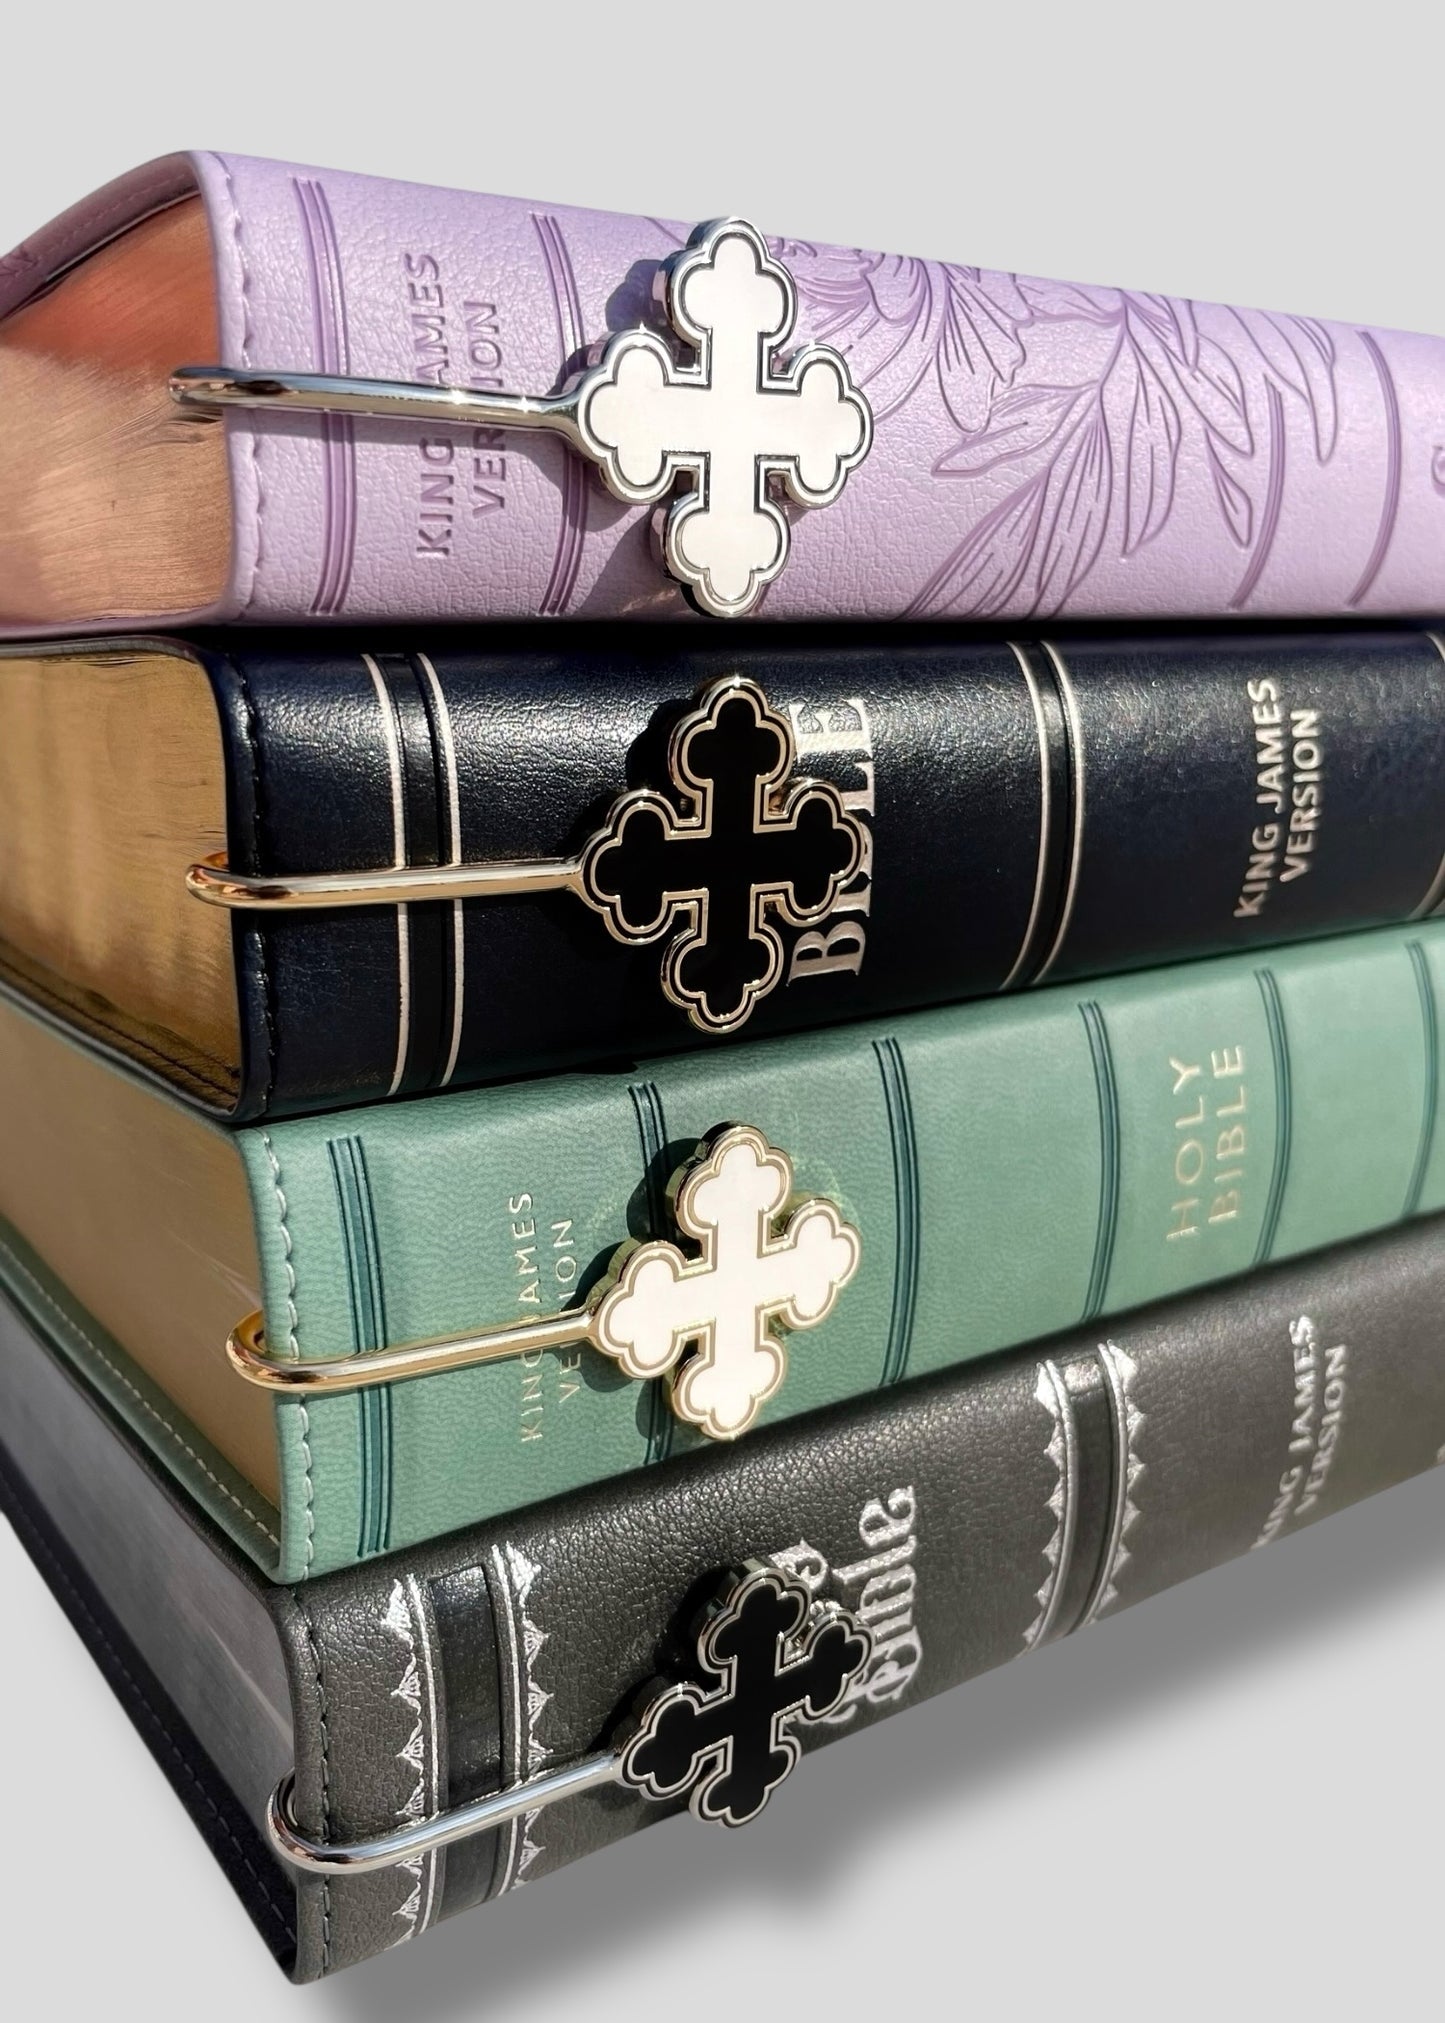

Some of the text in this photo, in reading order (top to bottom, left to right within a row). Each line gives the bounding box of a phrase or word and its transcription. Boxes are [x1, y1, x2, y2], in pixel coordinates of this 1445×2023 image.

[404, 252, 455, 558] KING AMES
[463, 300, 506, 520] VERION
[786, 698, 877, 987] BLE
[1233, 678, 1286, 918] KING JAMES
[1280, 708, 1323, 883] VERSION
[1166, 1056, 1204, 1240] HOLY
[1208, 1045, 1244, 1224] BIBLE
[509, 1192, 541, 1304] AMES
[551, 1219, 581, 1404] VEION
[1294, 1343, 1348, 1516] VERSION
